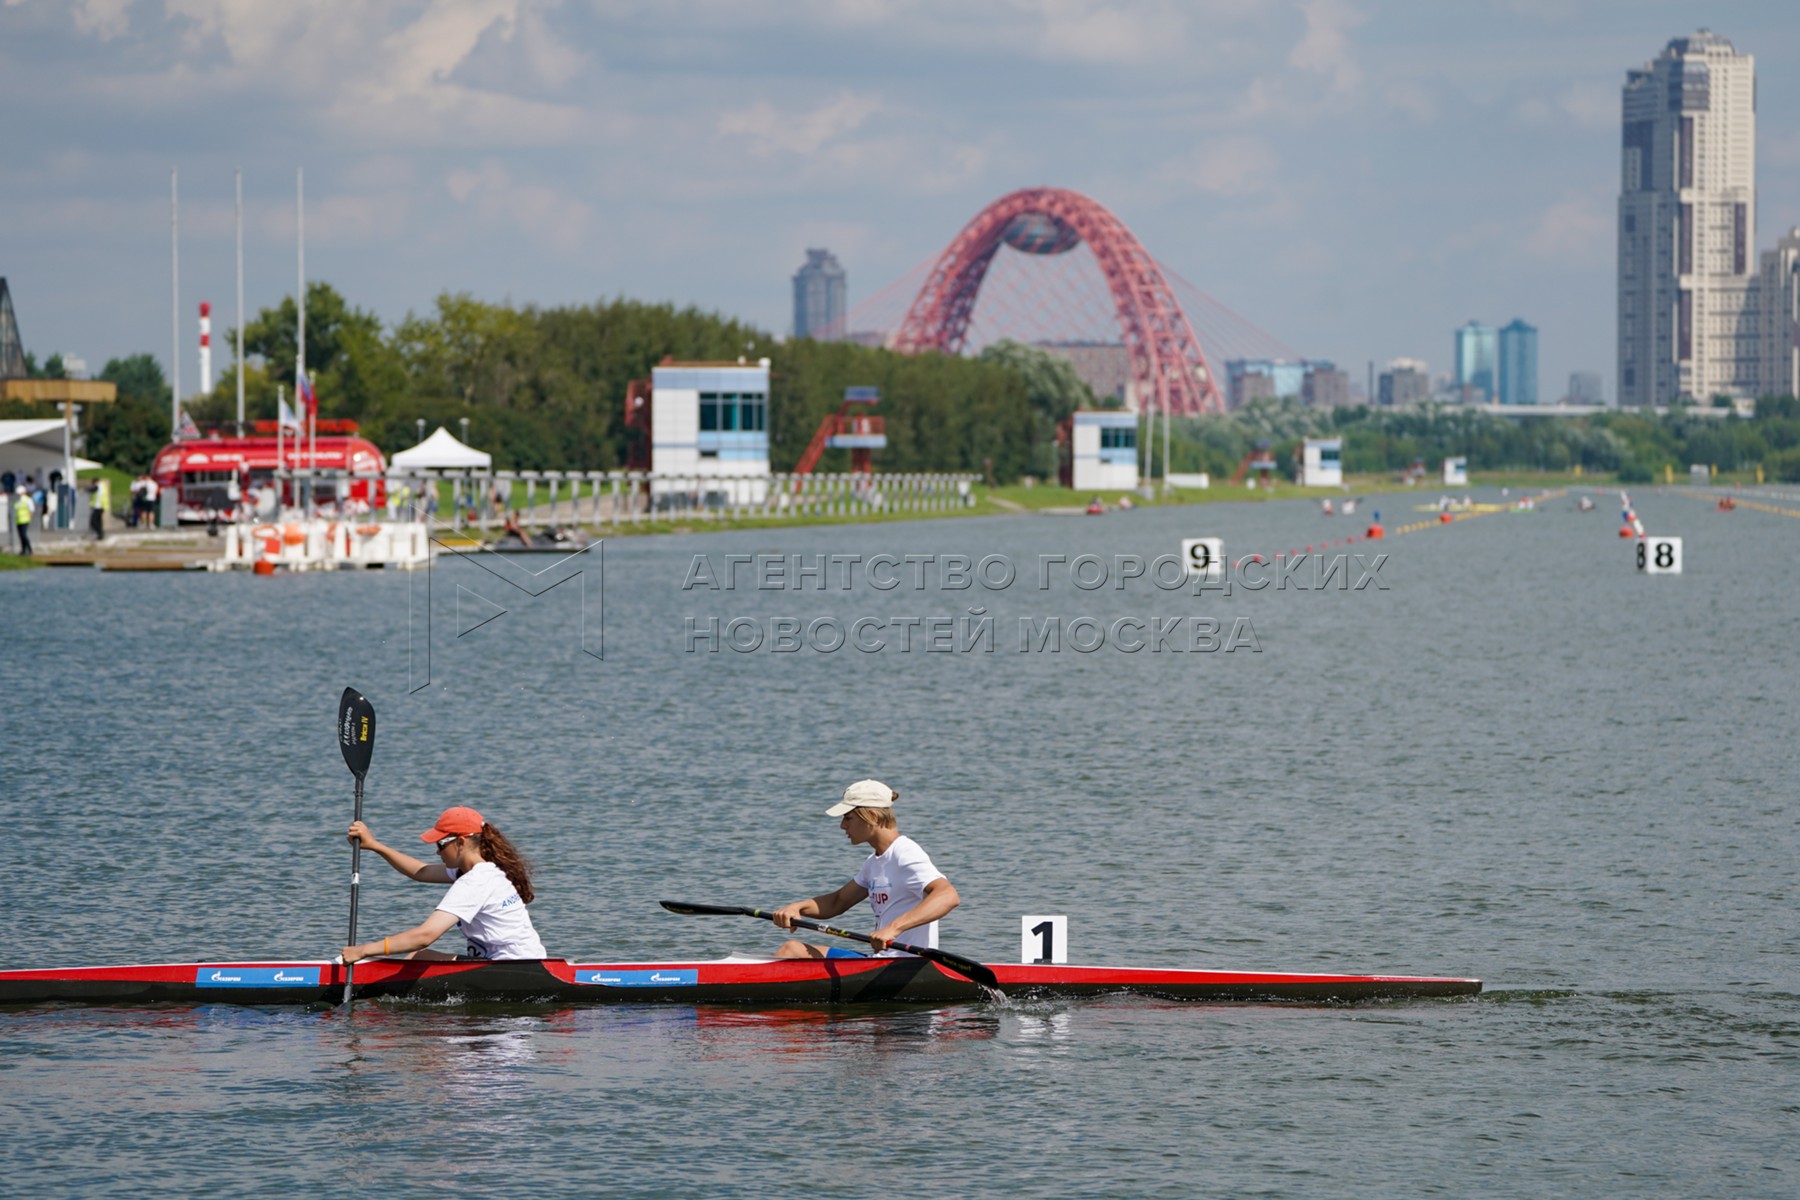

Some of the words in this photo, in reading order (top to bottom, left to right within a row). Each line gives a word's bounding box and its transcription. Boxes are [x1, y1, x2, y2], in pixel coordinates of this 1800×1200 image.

[1190, 544, 1210, 569] 9
[1655, 543, 1674, 568] 8
[1031, 921, 1053, 962] 1
